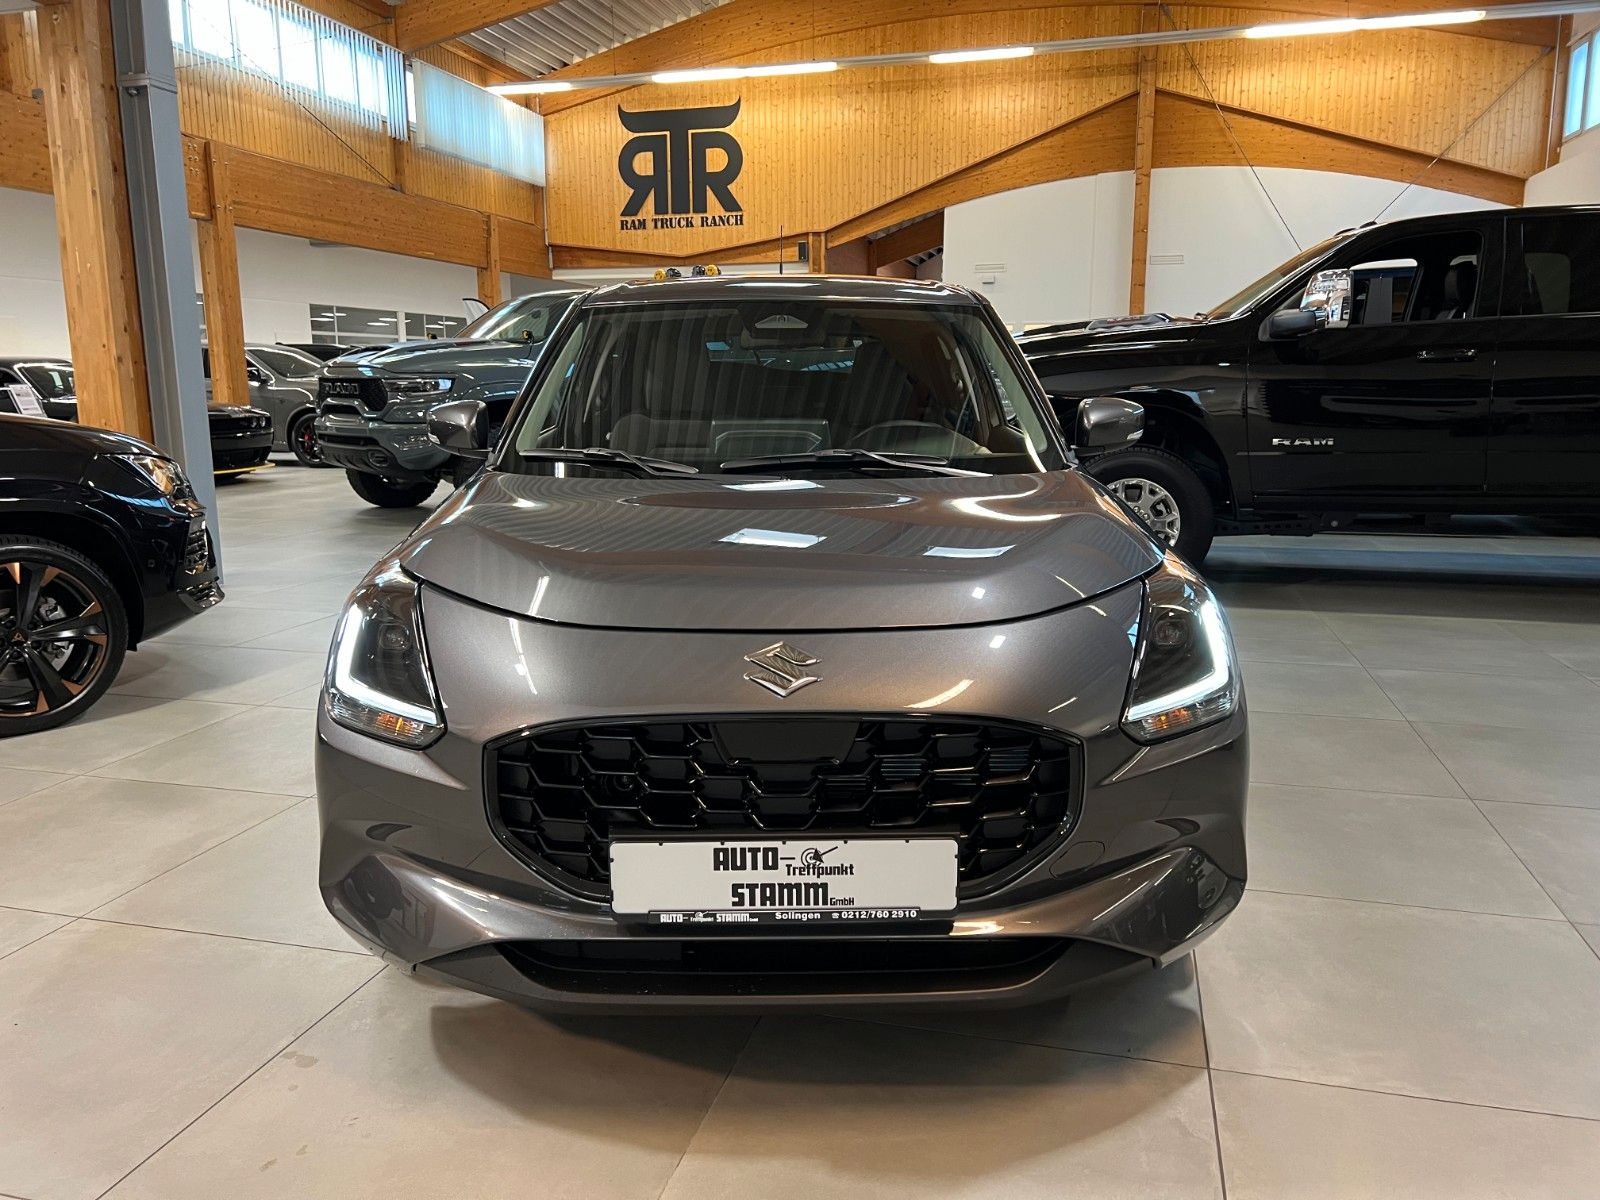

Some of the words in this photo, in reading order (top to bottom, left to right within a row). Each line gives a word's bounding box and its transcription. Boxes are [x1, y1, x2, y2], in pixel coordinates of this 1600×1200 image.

[620, 219, 647, 230] RAM
[652, 217, 694, 229] TRUCK
[700, 214, 744, 227] RANCH
[1272, 438, 1334, 446] RAM
[785, 863, 855, 878] Treffpunkt
[731, 882, 829, 906] STAMM
[829, 896, 855, 906] GmbH
[775, 911, 821, 921] Solingen
[841, 910, 890, 919] 0212/760
[891, 910, 917, 919] 2910
